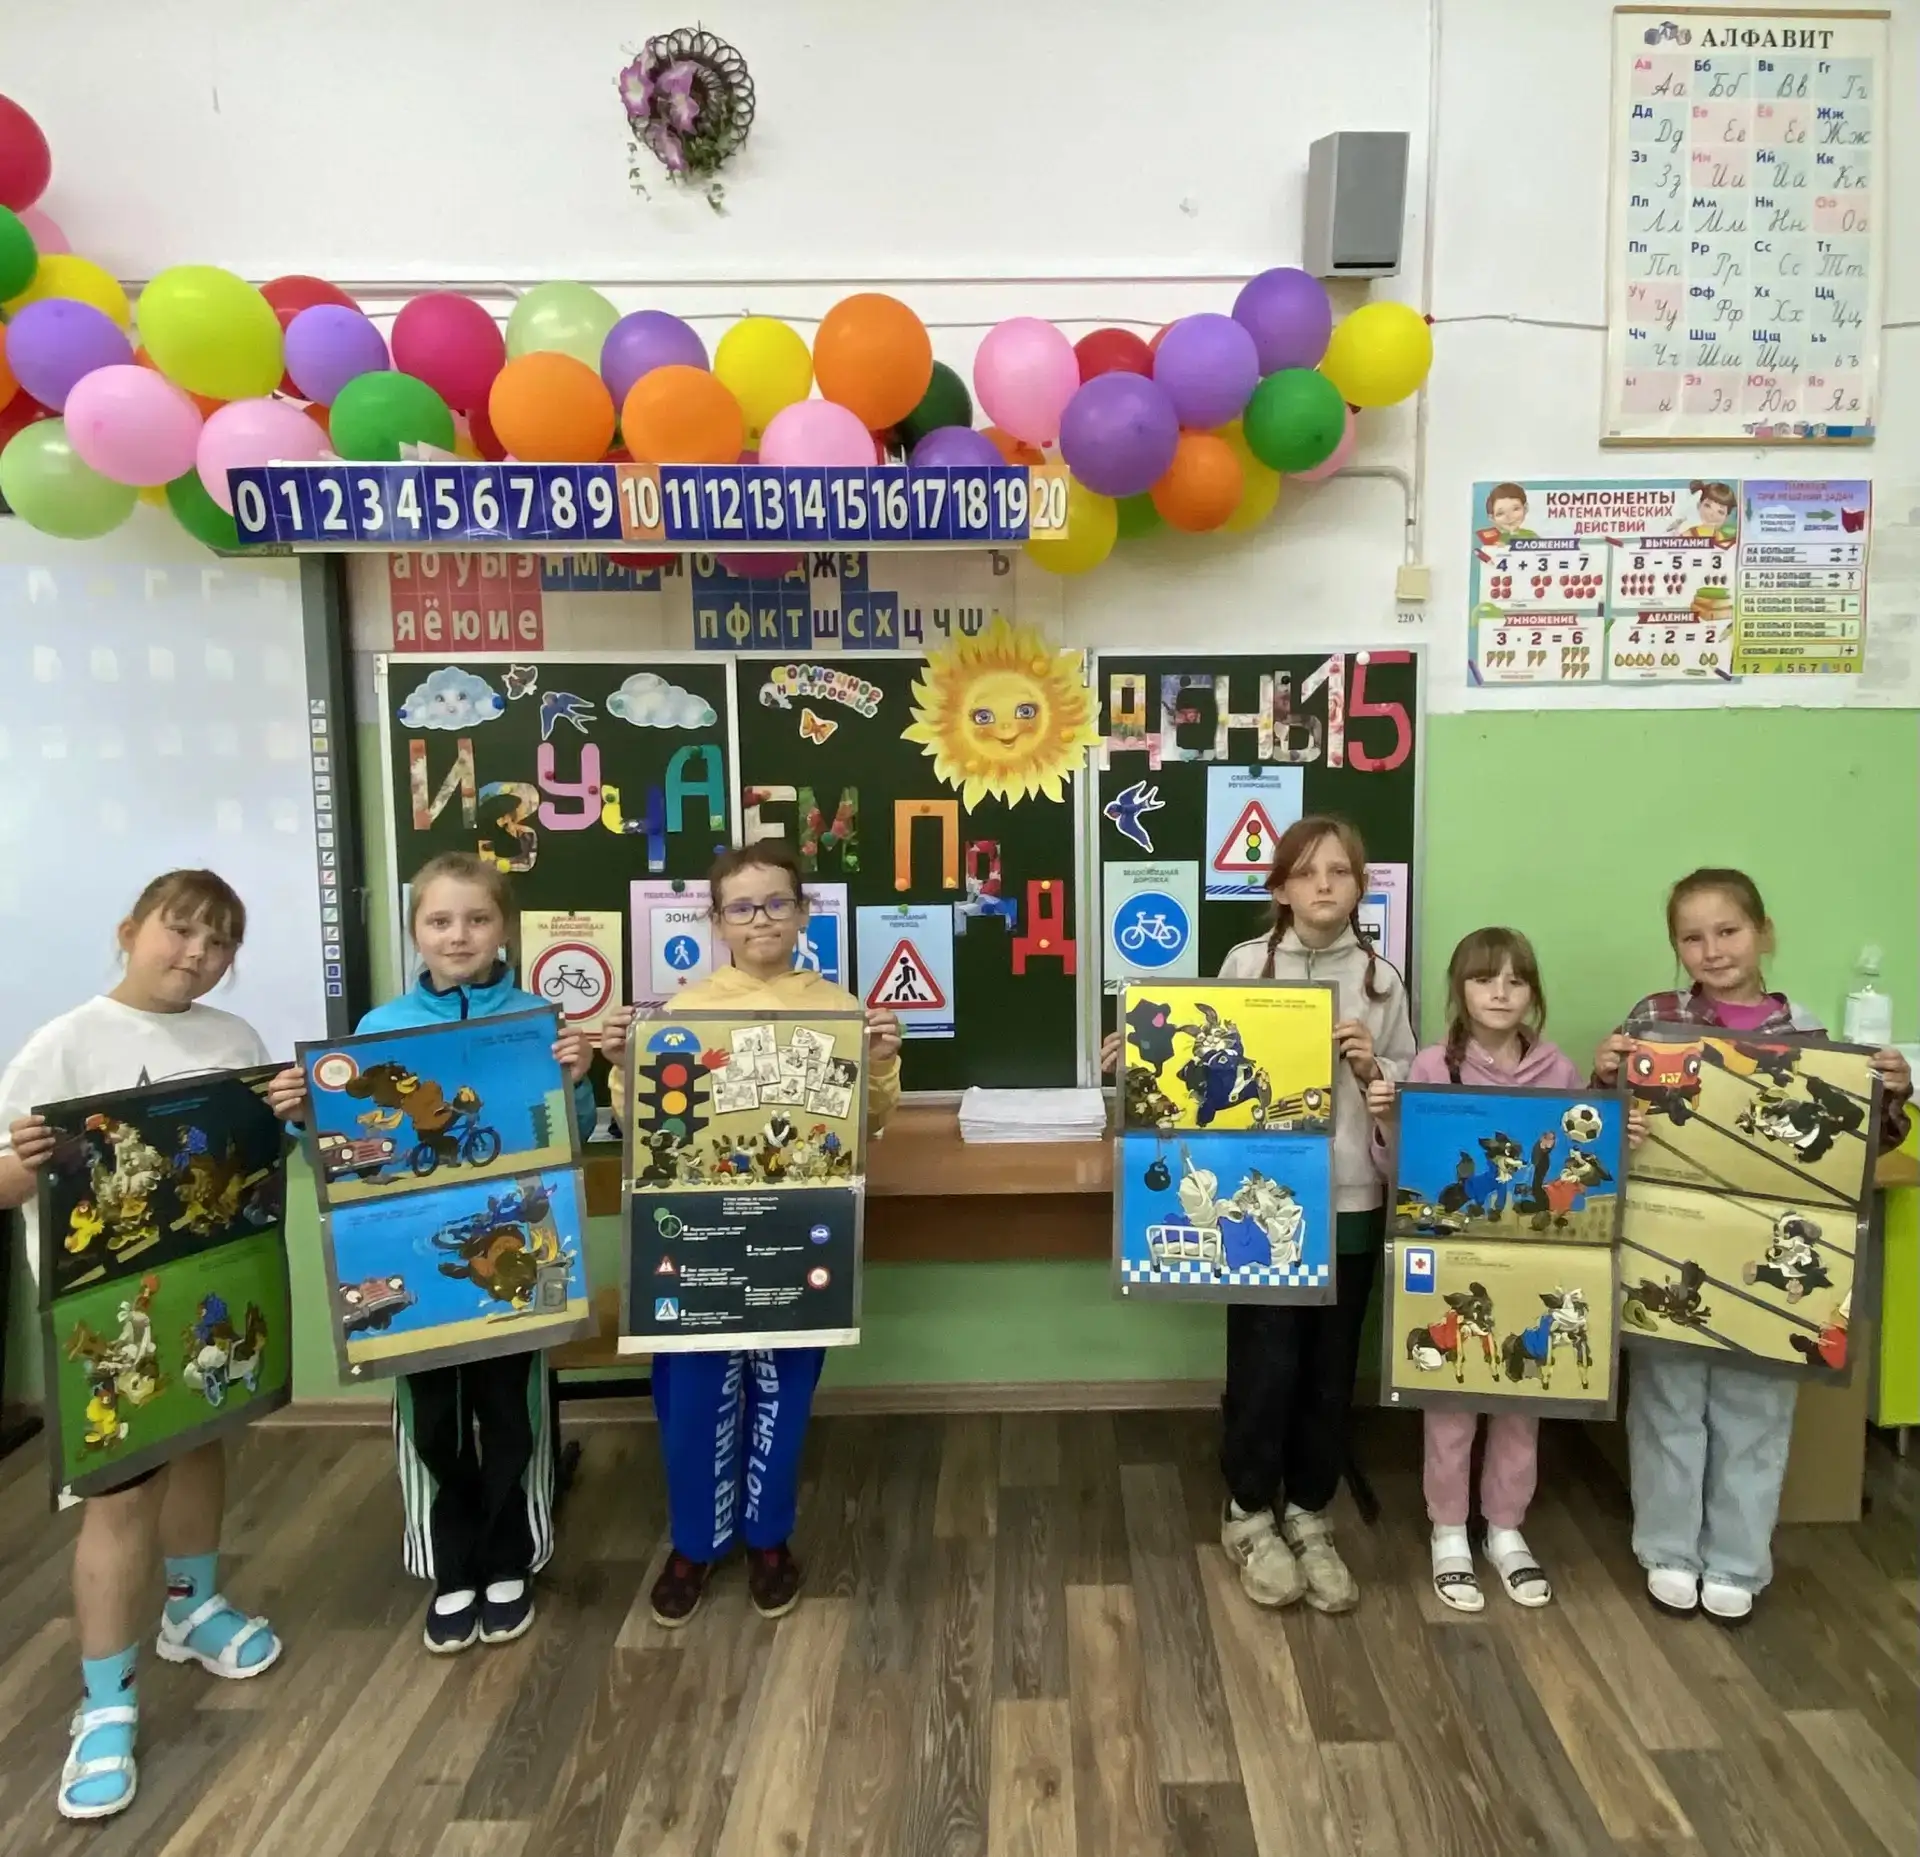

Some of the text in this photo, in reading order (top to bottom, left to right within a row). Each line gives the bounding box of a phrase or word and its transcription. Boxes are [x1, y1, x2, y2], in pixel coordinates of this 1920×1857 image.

[1700, 29, 1834, 50] АЛФАВИТ
[237, 476, 1066, 533] 0 1 2 3 4 5 6 7 8 9 10 11 12 13 14 15 16 17 18 19 20
[1547, 492, 1675, 505] КОМПОНЕНТЫ
[1548, 507, 1673, 518] МАТЕМАТИЧЕСКИХ
[1574, 520, 1646, 534] ДЕЙСТВИЙ
[1515, 541, 1575, 549] СЛОЖЕНИЕ
[1646, 540, 1710, 548] ВЫЧИТАНИЕ
[1497, 558, 1589, 571] 4 3 7
[1634, 556, 1722, 569] 8 5 3
[1397, 613, 1415, 623] 220
[1507, 616, 1575, 624] УМНОЖЕНИЕ
[1647, 614, 1695, 622] ДЕЛЕНИЕ
[1497, 632, 1583, 645] 3 2 6
[1628, 631, 1716, 643] 4 2 2
[1099, 650, 1412, 772] ДЕНЬ 15
[894, 800, 1077, 976] ПДД
[665, 913, 698, 923] ЗОНА
[1659, 1072, 1682, 1084] 137
[753, 1401, 779, 1456] THE
[715, 1413, 736, 1477] THE
